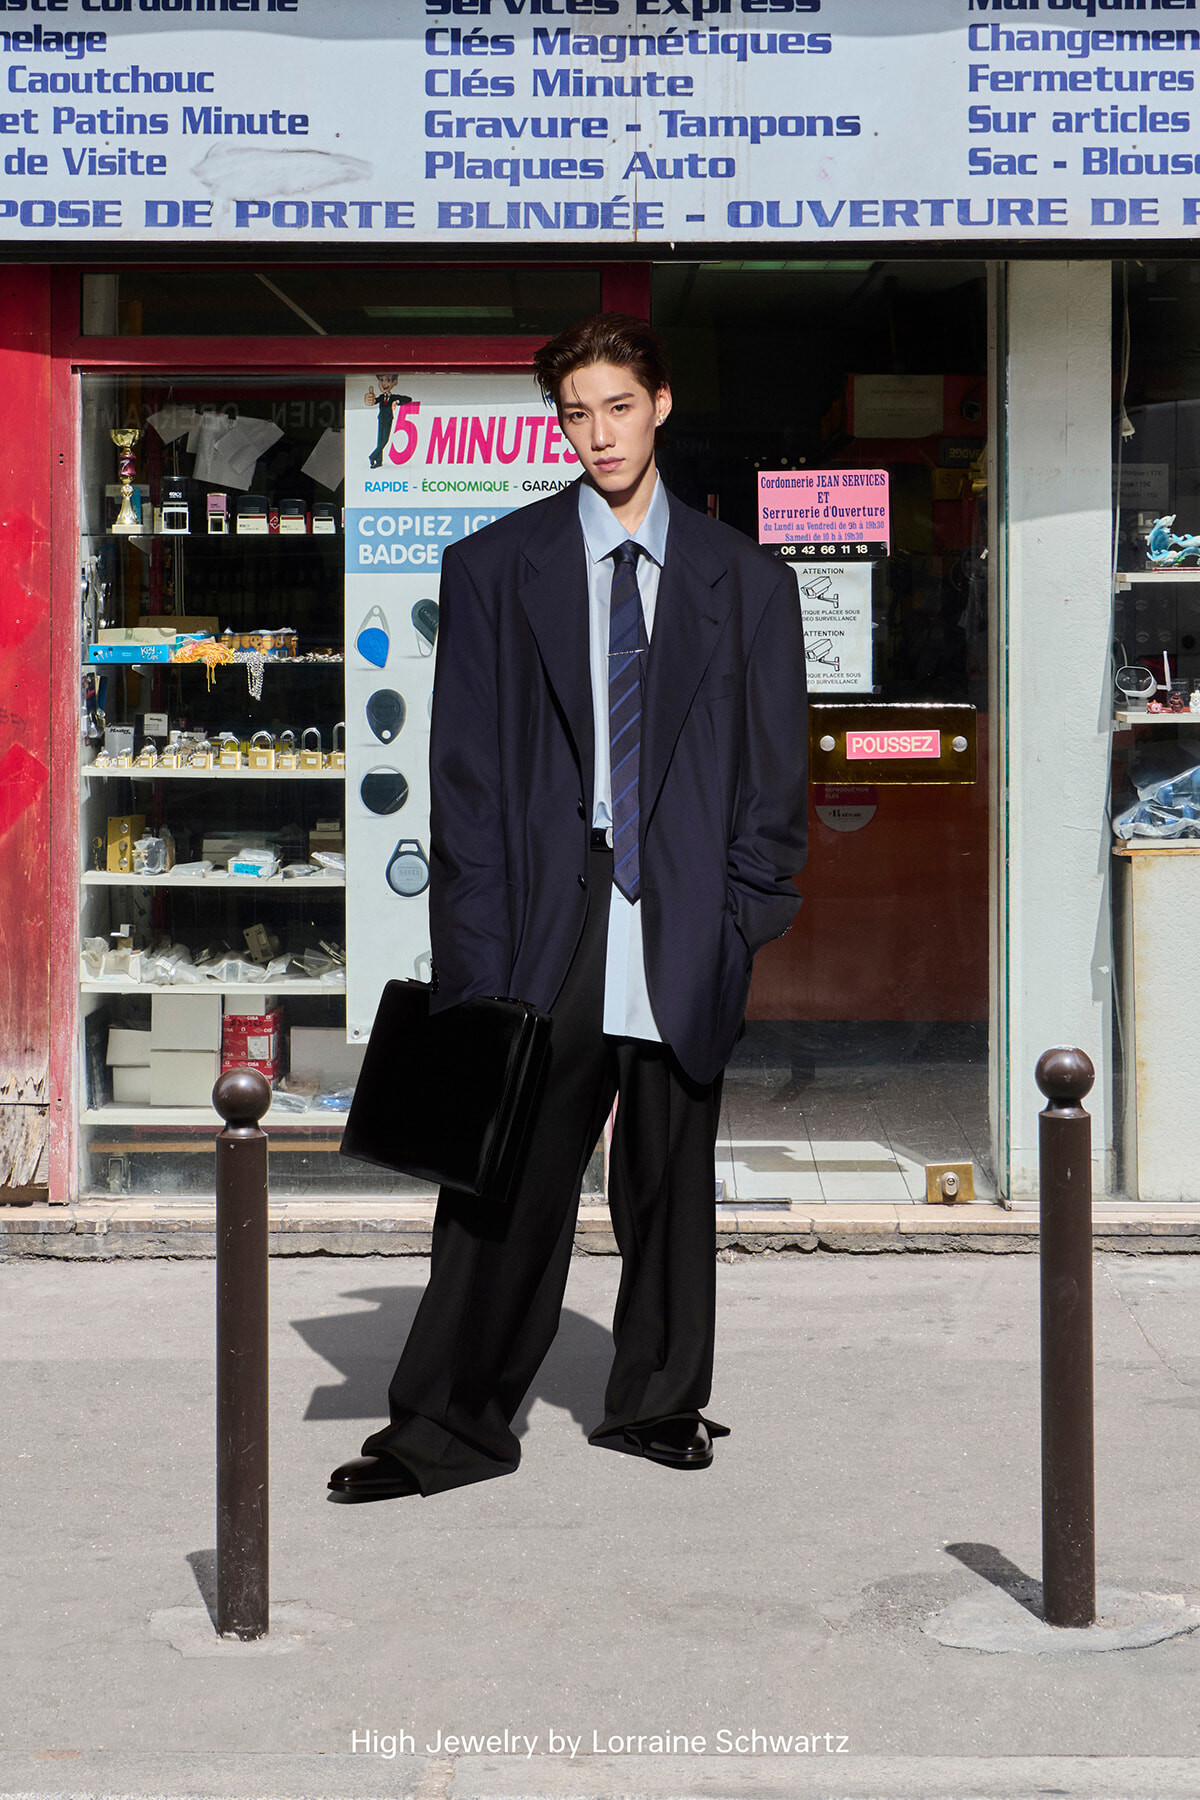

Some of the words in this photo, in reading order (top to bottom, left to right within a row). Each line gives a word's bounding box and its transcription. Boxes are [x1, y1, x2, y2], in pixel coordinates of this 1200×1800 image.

[425, 27, 515, 56] Clés
[532, 26, 832, 62] Magnétiques
[8, 65, 214, 93] Caoutchouc
[425, 69, 515, 97] Clés
[532, 69, 694, 97] Minute
[968, 64, 1194, 92] Fermetures
[0, 109, 39, 134] et
[53, 106, 169, 135] Patins
[182, 106, 309, 135] Minute
[425, 110, 608, 138] Gravure
[659, 109, 861, 144] Tampons
[968, 105, 1036, 133] Sur
[1052, 104, 1190, 133] articles
[4, 147, 48, 175] de
[62, 147, 167, 175] Visite
[425, 151, 604, 186] Plaques
[622, 151, 736, 179] Auto
[968, 147, 1037, 175] Sac
[1082, 146, 1200, 175] Blous
[145, 200, 212, 228] DE
[234, 200, 416, 229] PORTE
[437, 195, 664, 229] BLINDÉE
[727, 198, 1068, 227] OUVERTURE
[1091, 198, 1159, 226] DE
[388, 401, 421, 465] 5
[364, 481, 408, 493] RAPIDE
[421, 478, 509, 493] ÉCONOMIQUE
[760, 475, 814, 488] Cordonnerie
[816, 475, 839, 488] JEAN
[842, 473, 886, 487] SERVICES
[762, 506, 820, 519] Serrurerie
[823, 504, 886, 518] d'Ouverture
[817, 491, 830, 504] ET
[358, 515, 453, 537] COPIEZ
[763, 522, 773, 531] du
[774, 522, 794, 531] Lundi
[806, 521, 837, 530] Vendredi
[838, 521, 847, 530] de
[848, 521, 857, 530] 9h
[858, 520, 864, 529] à
[865, 520, 885, 530] 19h30
[784, 532, 811, 542] Samedi
[813, 532, 821, 541] de
[822, 532, 830, 541] 10
[831, 532, 836, 541] h
[837, 531, 842, 540] à
[844, 531, 864, 541] 19h30
[358, 544, 439, 565] BADGE
[780, 545, 797, 555] 06
[801, 545, 816, 555] 42
[820, 545, 836, 555] 66
[840, 545, 851, 554] 11
[855, 544, 868, 554] 18
[802, 567, 844, 575] ATTENTION
[852, 736, 933, 753] POUSSEZ
